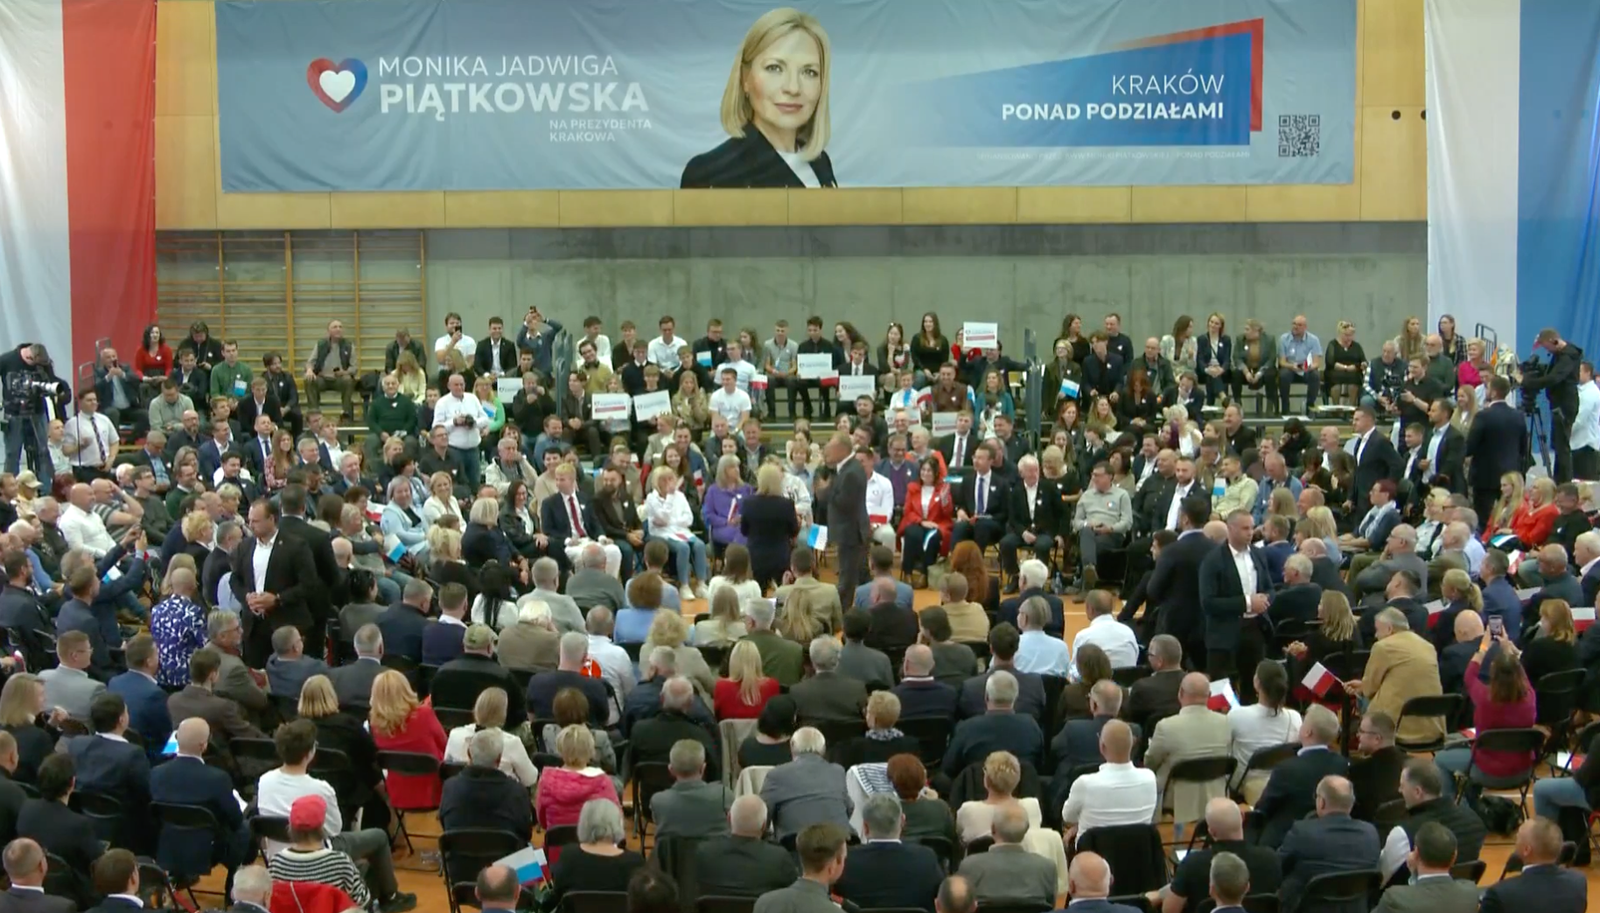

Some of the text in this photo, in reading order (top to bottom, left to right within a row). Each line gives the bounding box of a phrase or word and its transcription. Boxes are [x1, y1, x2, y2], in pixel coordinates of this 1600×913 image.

[379, 55, 619, 77] MONIKA JADWIGA
[1112, 68, 1225, 96] KRAKÓW
[380, 82, 650, 121] PIĄTKOWSKA
[1002, 102, 1224, 121] PONAD PODZIAŁAMI
[549, 119, 652, 130] NA PREZYDENTA
[549, 131, 616, 142] KRAKOWA
